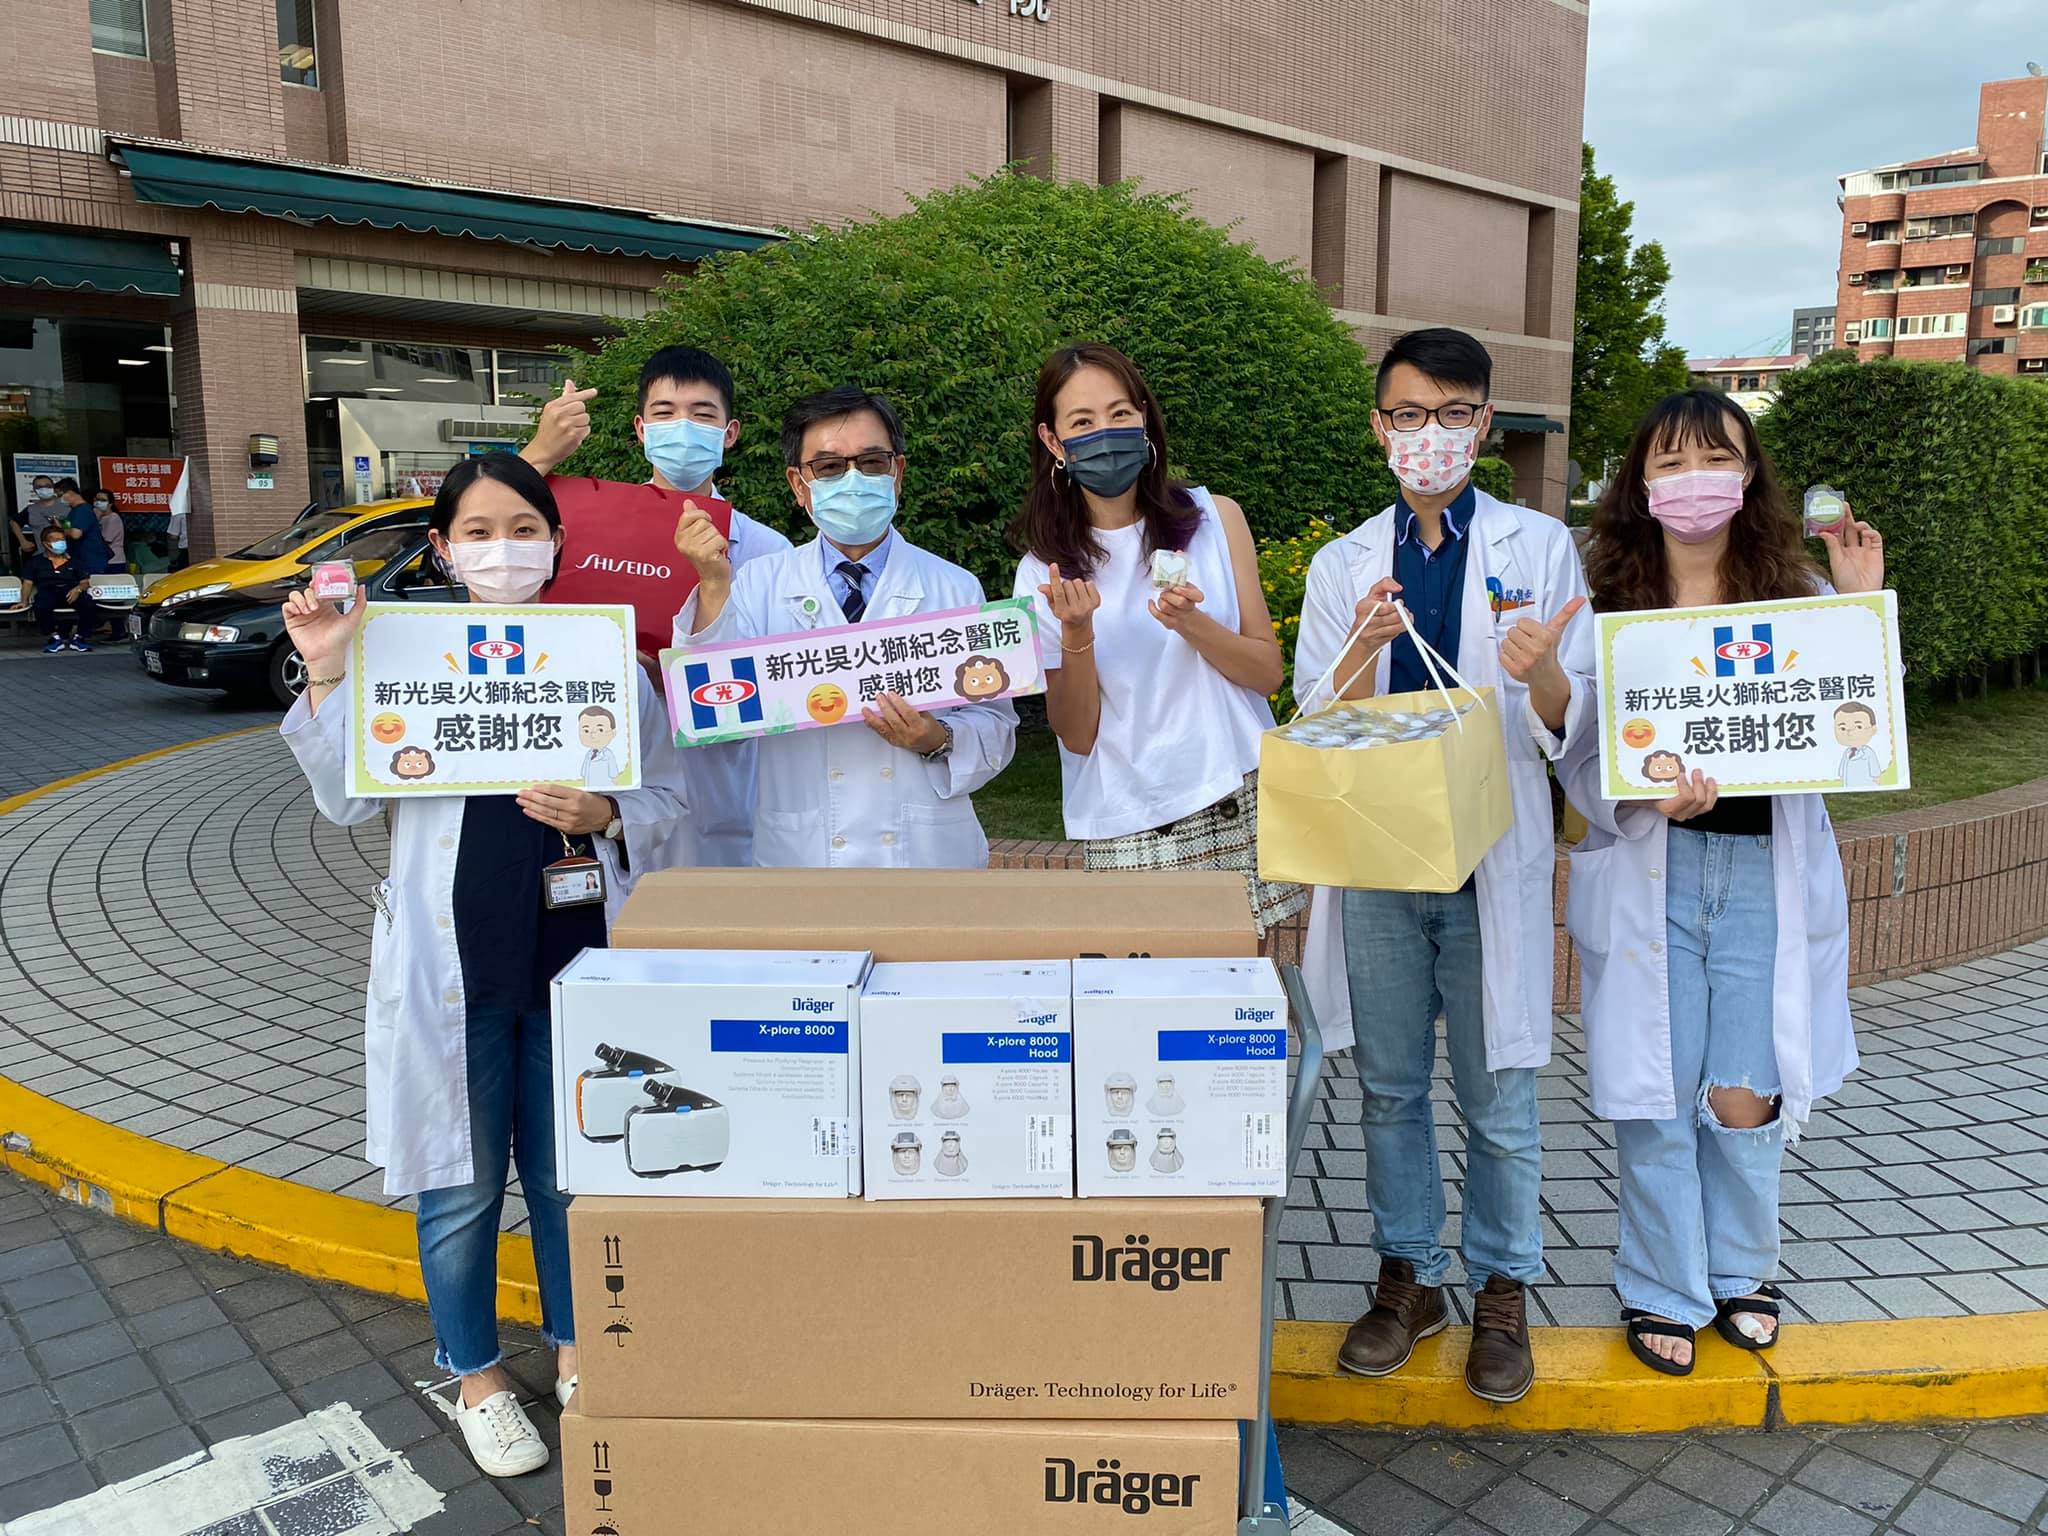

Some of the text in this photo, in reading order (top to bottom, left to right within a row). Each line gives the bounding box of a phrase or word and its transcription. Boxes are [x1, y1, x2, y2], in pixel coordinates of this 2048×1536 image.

[575, 553, 671, 579] SHISEIDO
[764, 617, 1023, 682] 新光吳火獅紀念醫院
[374, 679, 617, 707] 新光吳火獅紀念醫院
[857, 665, 944, 703] 感謝您
[1624, 673, 1877, 713] 新光吳火獅紀念醫院
[432, 712, 564, 752] 感謝您
[1682, 711, 1819, 755] 感謝您
[792, 997, 835, 1014] Dräger
[1235, 1007, 1276, 1023] Dräger
[758, 1024, 836, 1037] X-plore 8000
[987, 1036, 1059, 1047] X-plore 8000
[1207, 1033, 1276, 1046] X-plore 8000
[1029, 1048, 1059, 1058] Hood
[1246, 1045, 1276, 1056] Hood
[1072, 1234, 1231, 1291] Dräger
[969, 1382, 1039, 1402] Dräger.
[1044, 1382, 1154, 1402] Technology
[1160, 1382, 1186, 1398] for
[1044, 1457, 1201, 1515] Dräger
